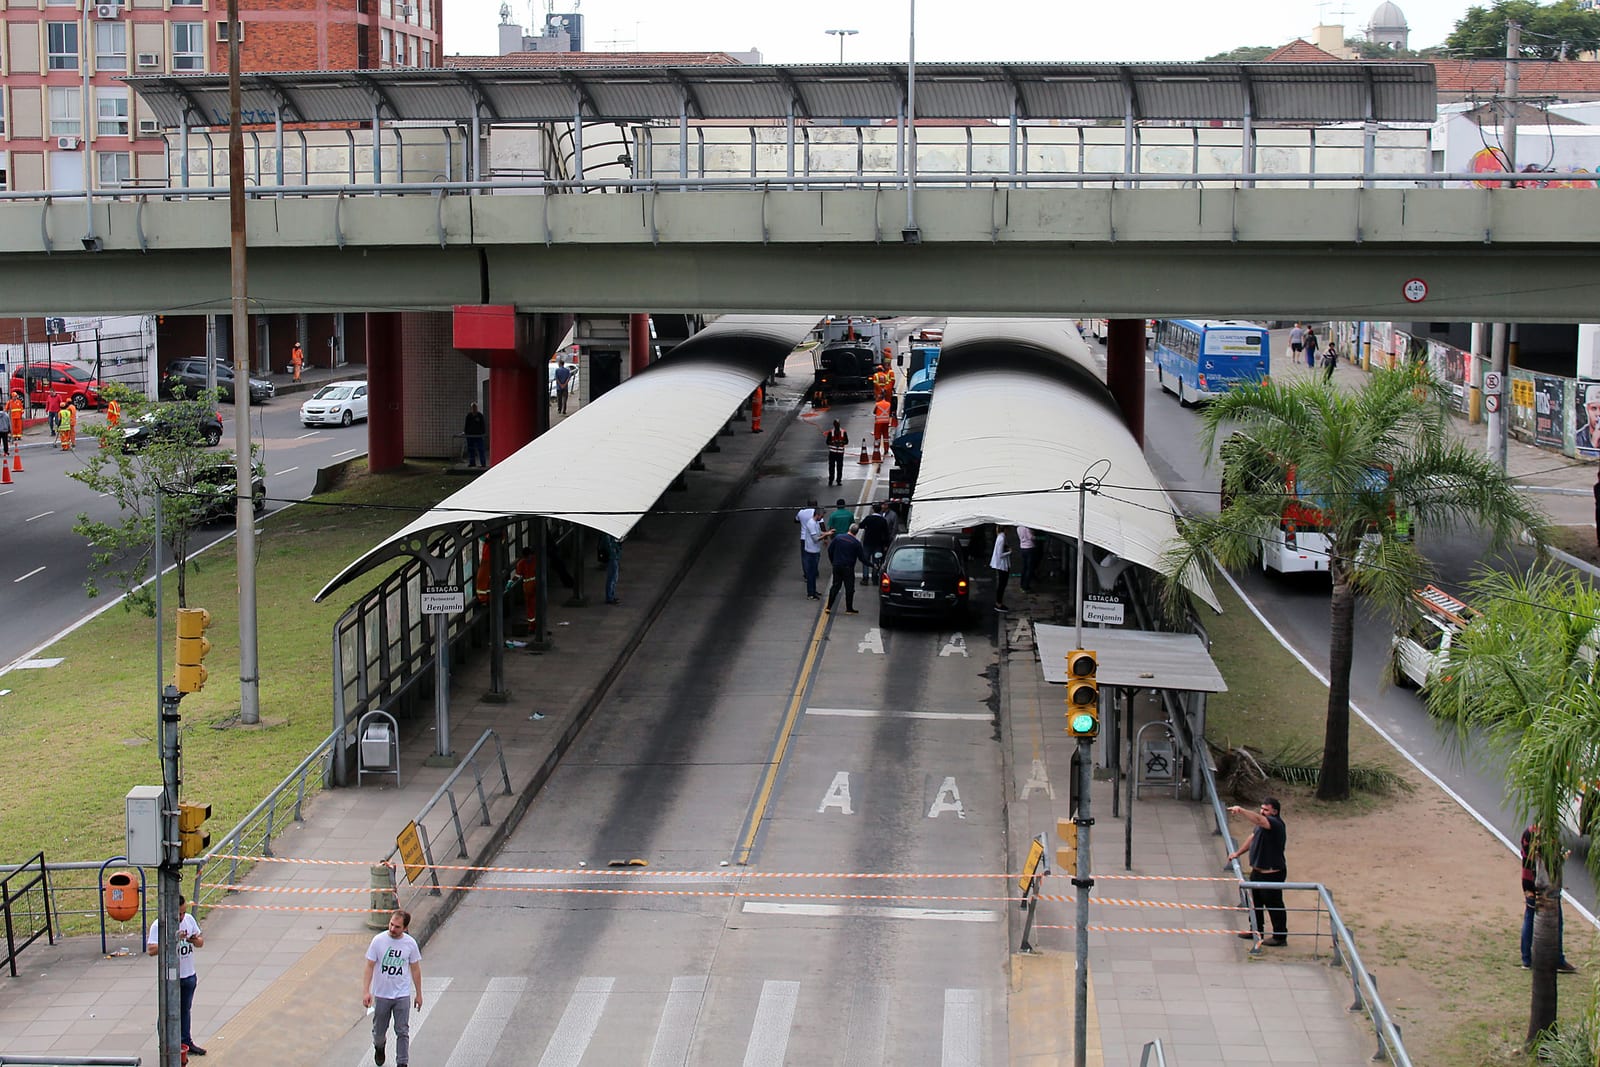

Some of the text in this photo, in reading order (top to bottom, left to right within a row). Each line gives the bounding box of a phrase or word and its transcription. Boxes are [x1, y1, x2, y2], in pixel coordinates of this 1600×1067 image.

[426, 585, 459, 593] ESTAÇÃO
[1088, 594, 1120, 603] ESTAÇÃO
[426, 603, 463, 612] Benjamin
[1087, 611, 1122, 622] Benjamin
[816, 771, 855, 815] A
[927, 776, 966, 819] A
[388, 949, 402, 958] EU
[381, 965, 403, 976] POA
